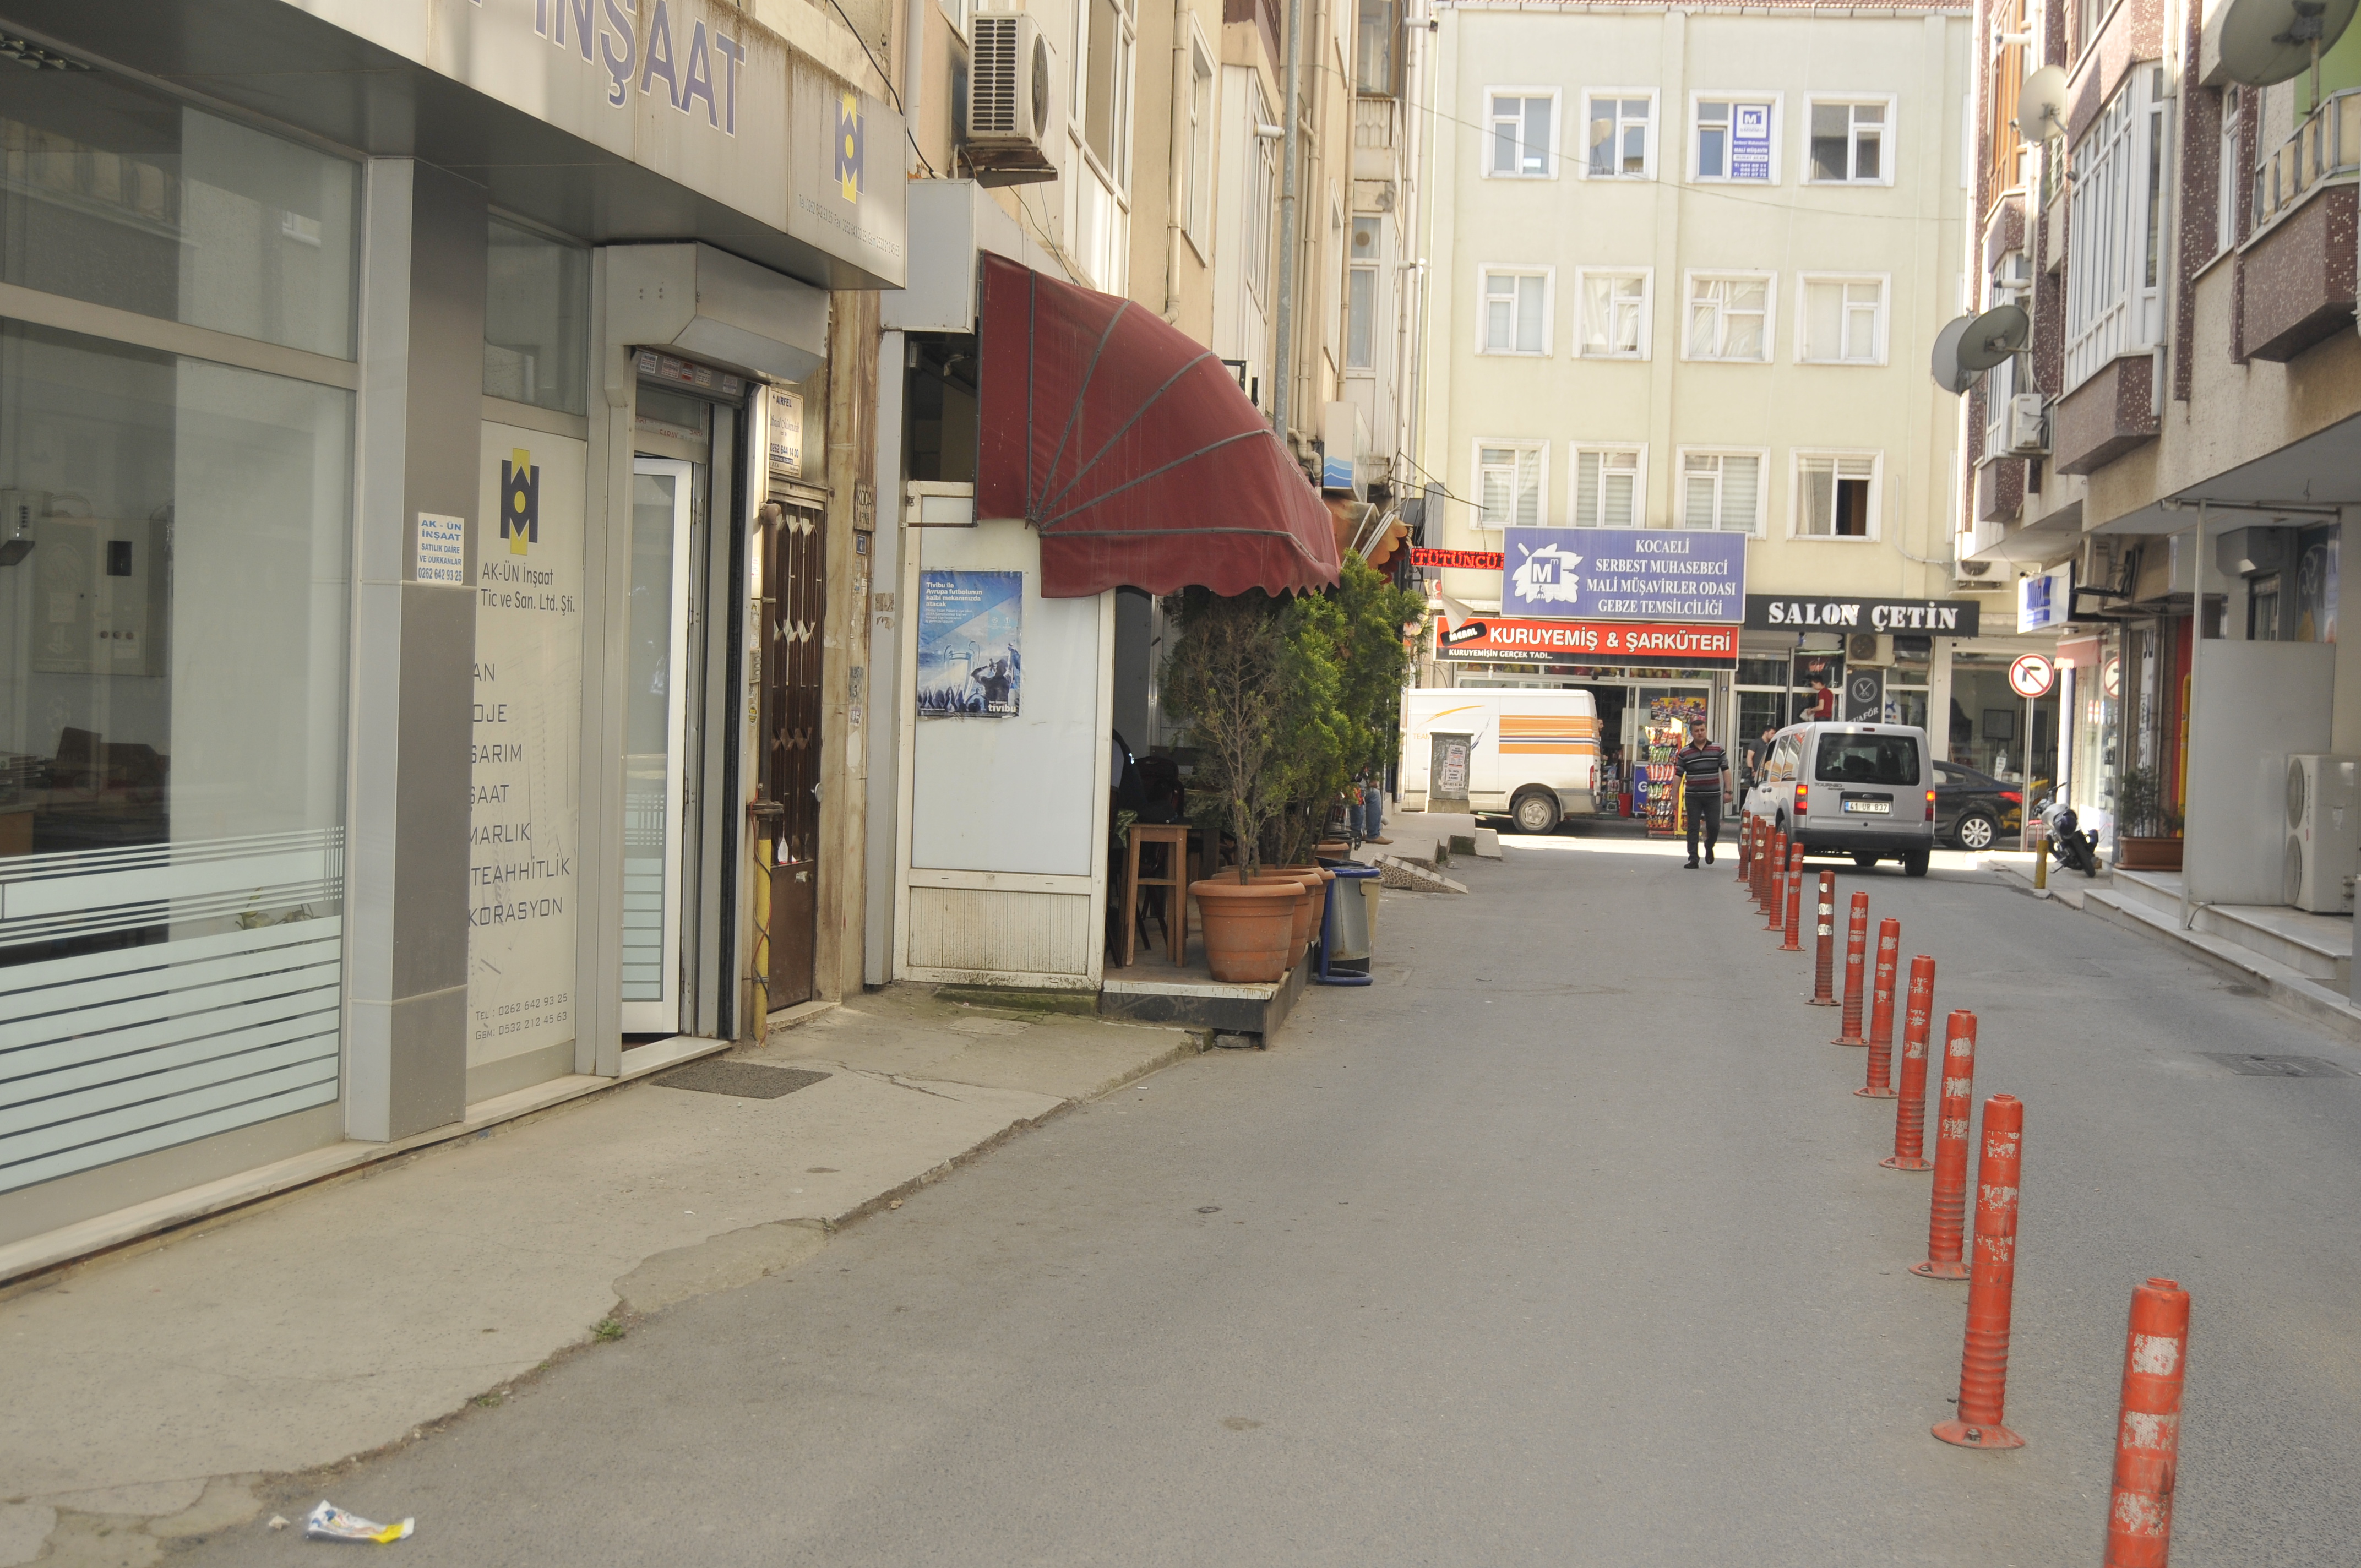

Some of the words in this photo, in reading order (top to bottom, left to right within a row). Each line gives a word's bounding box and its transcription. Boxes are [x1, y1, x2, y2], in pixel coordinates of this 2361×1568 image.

[421, 519, 437, 528] AK
[447, 521, 461, 531] ÜN
[422, 529, 461, 541] İNŞAAT
[421, 542, 443, 553] SATILIK
[444, 544, 460, 554] DAİRE
[1636, 537, 1690, 554] KOCAELİ
[419, 555, 427, 563] VE
[1596, 558, 1647, 573] SERBEST
[1650, 559, 1728, 575] MUHASEBECİ
[418, 567, 433, 579] 0262
[434, 568, 445, 580] 642
[447, 569, 454, 581] 93
[455, 570, 462, 582] 25
[482, 560, 519, 582] AK-ÜN
[523, 562, 554, 588] İnşaat
[1586, 576, 1618, 592] MALİ
[1620, 576, 1697, 596] MÜŞAVİRLER
[1699, 581, 1736, 596] ODASI
[481, 587, 497, 607] Tic
[500, 593, 512, 608] ve
[514, 591, 536, 610] San.
[540, 593, 558, 612] Ltd.
[561, 595, 575, 616] Şti.
[1598, 598, 1638, 613] GEBZE
[1640, 598, 1723, 616] TEMSİLCİLİĞİ
[1768, 601, 1860, 626] SALON
[1871, 601, 1959, 632] ÇETİN
[1489, 626, 1598, 651] KURUYEMİŞ
[1606, 631, 1619, 648] &
[1626, 629, 1731, 653] ŞARKÜTERİ
[1449, 648, 1498, 658] KURUYEMİŞİN
[1499, 650, 1528, 660] GERÇEK
[988, 704, 1016, 713] tivibu
[1848, 706, 1879, 723] UAFÖR
[1874, 803, 1888, 812] 837
[471, 853, 570, 886] TEAHHİTLİK
[498, 1002, 521, 1016] 0262
[524, 998, 541, 1011] 642
[544, 995, 554, 1006] 93
[557, 993, 568, 1004] 25
[498, 1021, 521, 1036] 0532
[524, 1016, 541, 1030] 212
[543, 1014, 554, 1025] 45
[557, 1011, 568, 1022] 63
